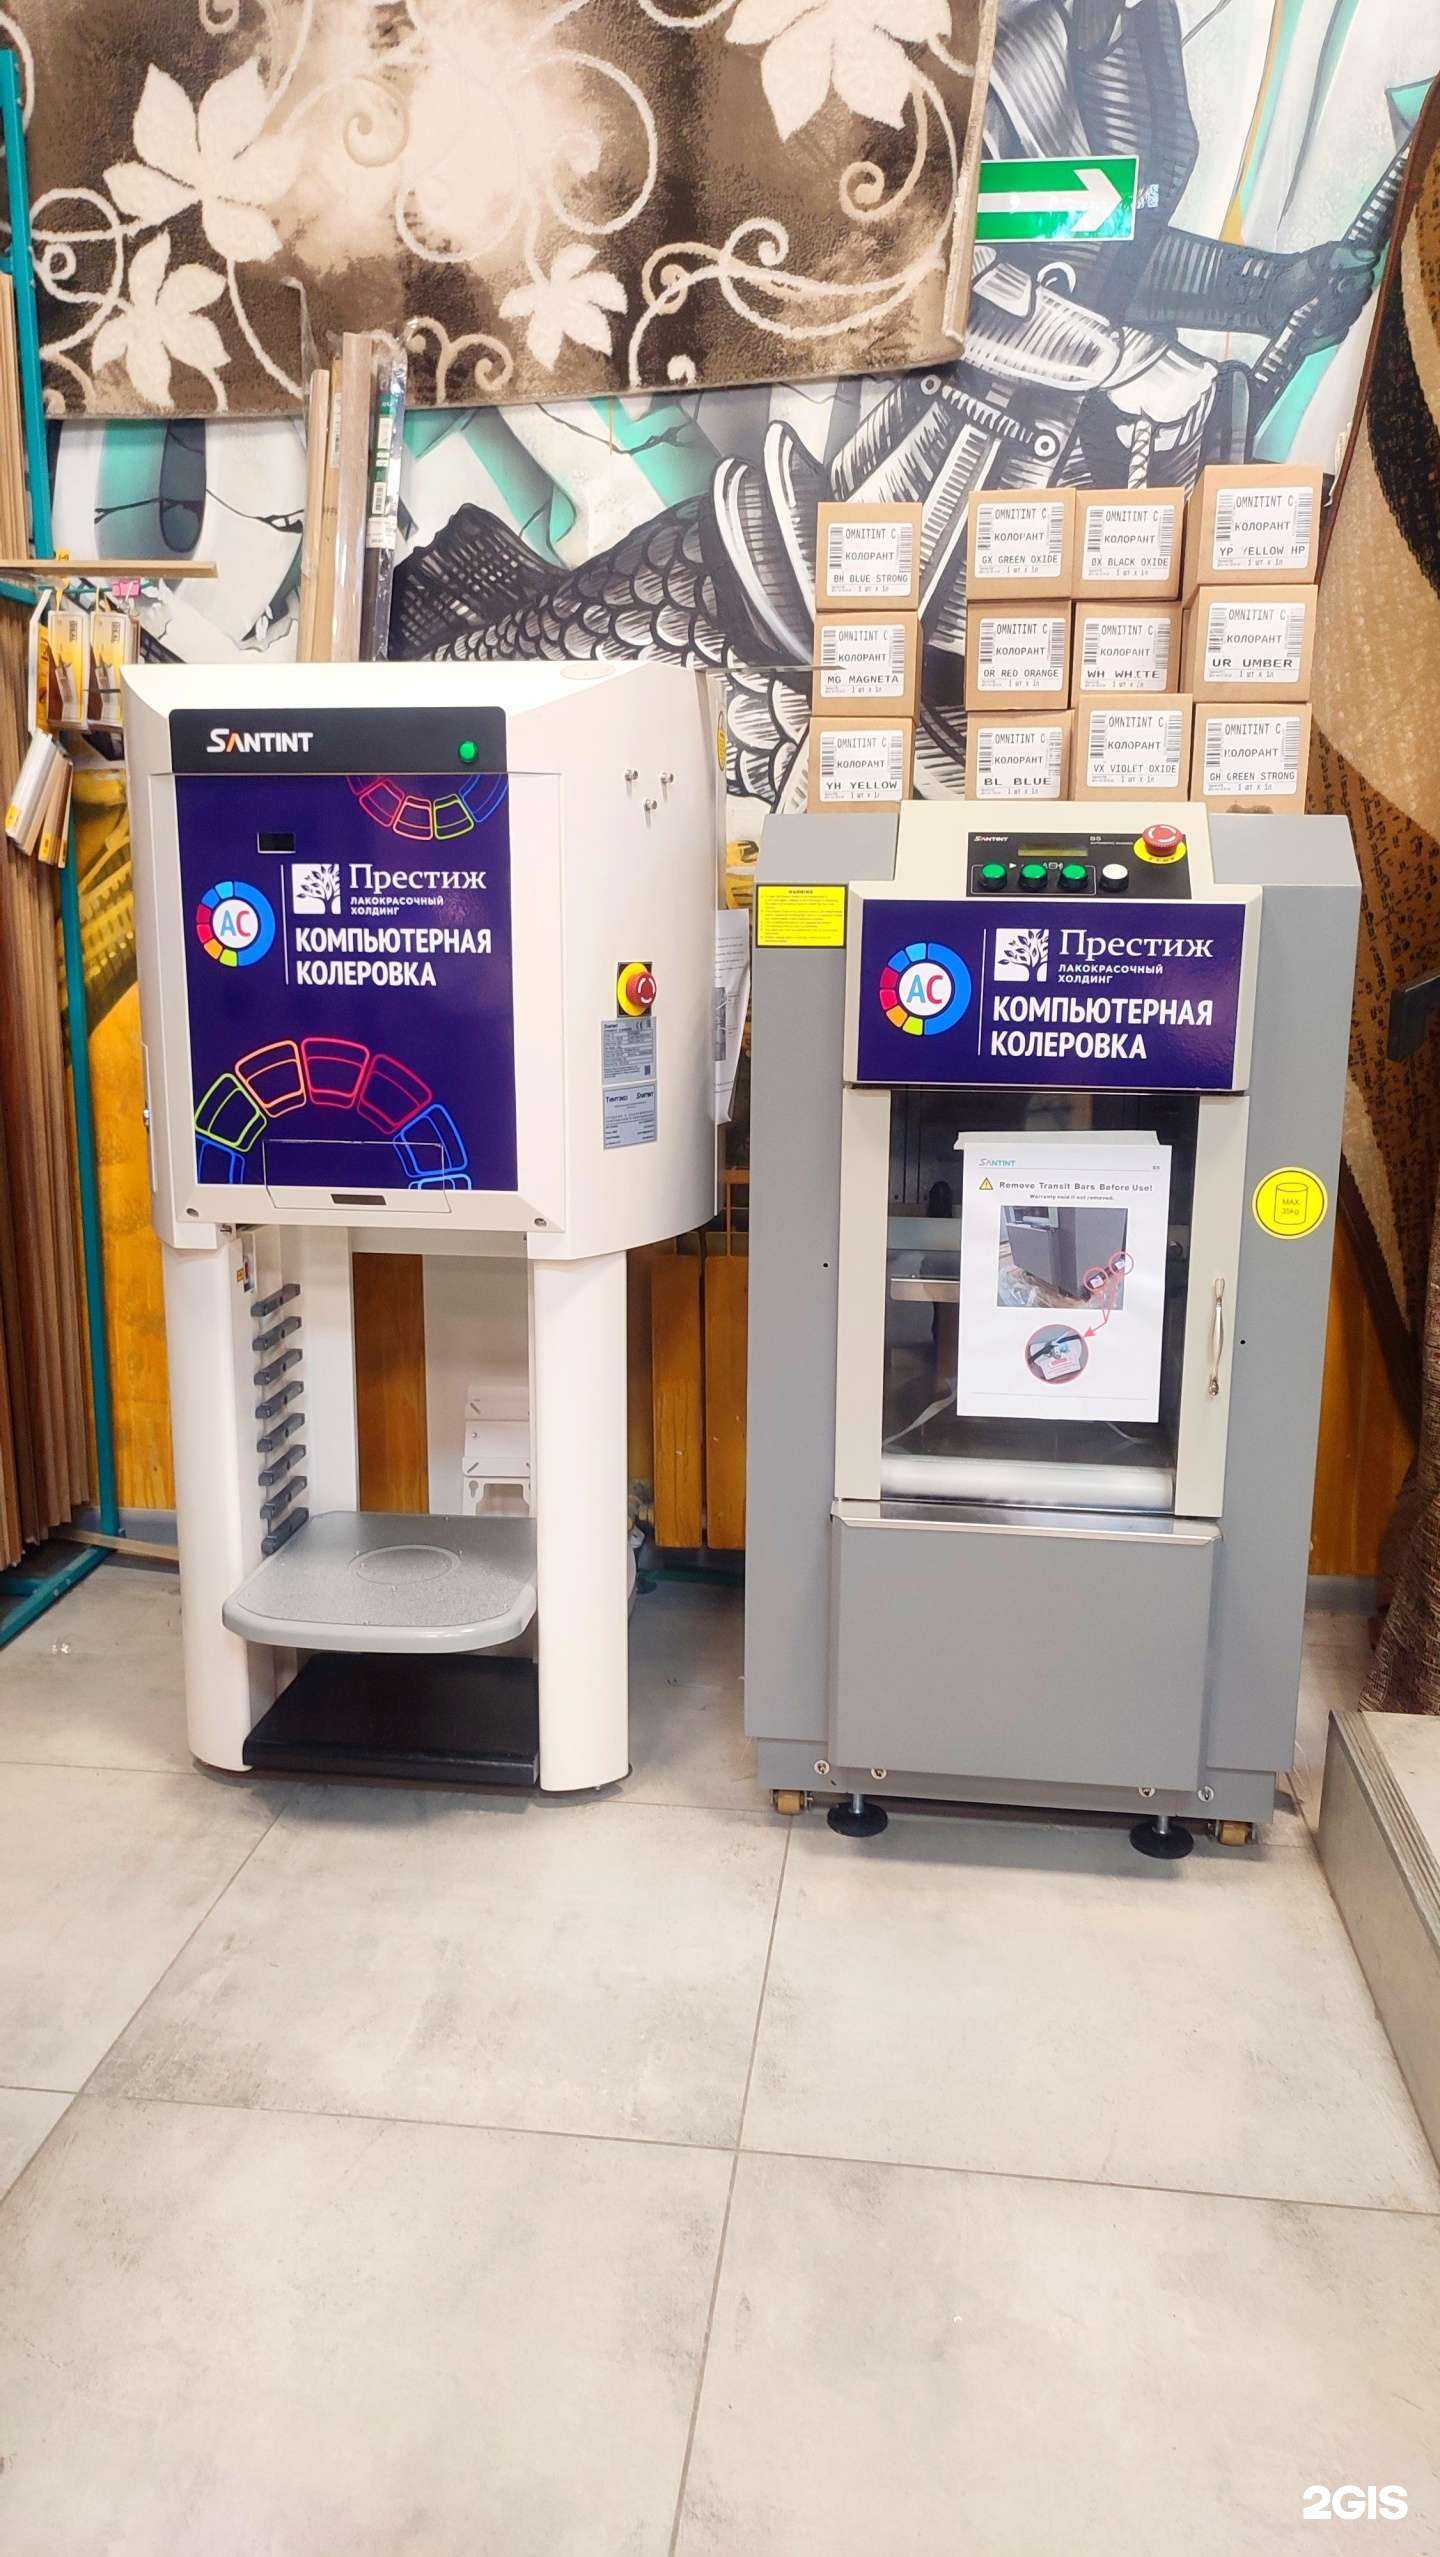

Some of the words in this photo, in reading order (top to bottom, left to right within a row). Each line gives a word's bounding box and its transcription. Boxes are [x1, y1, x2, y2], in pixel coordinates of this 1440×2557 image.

[1236, 496, 1282, 508] OMNITINT
[1288, 495, 1293, 506] C
[995, 509, 1036, 519] OMNITINT
[1042, 509, 1046, 518] C
[1106, 511, 1147, 521] OMNITINT
[1153, 511, 1158, 521] C
[1235, 522, 1289, 531] КОЛОРАНТ
[846, 529, 885, 538] OMNITINT
[891, 529, 896, 539] C
[995, 533, 1044, 541] КОЛОРАНТ
[846, 552, 893, 560] КОЛОРАНТ
[1220, 548, 1233, 556] YP
[1292, 546, 1305, 554] HP
[1108, 558, 1135, 566] BLACK
[1141, 558, 1168, 566] OXIDE
[1229, 609, 1274, 620] OMNITINT
[1280, 610, 1286, 620] C
[997, 624, 1036, 634] OMNITINT
[1043, 624, 1047, 633] C
[1102, 625, 1142, 635] OMNITINT
[1148, 625, 1153, 635] C
[839, 631, 878, 640] OMNITINT
[884, 631, 888, 640] C
[1227, 635, 1281, 643] КОЛОРАНТ
[1100, 648, 1150, 656] КОЛОРАНТ
[1213, 659, 1231, 667] UR
[1243, 659, 1292, 667] UMBER
[849, 675, 898, 683] MAGNETA
[1115, 670, 1159, 678] WHITE
[1109, 717, 1152, 727] OMNITINT
[1159, 717, 1163, 727] C
[1225, 724, 1269, 735] OMNITINT
[1276, 724, 1280, 733] C
[206, 728, 313, 753] SANTINT
[837, 738, 876, 748] OMNITINT
[882, 737, 886, 747] C
[995, 734, 1035, 744] OMNITINT
[1041, 734, 1045, 743] C
[1225, 749, 1278, 757] КОЛОРАНТ
[1149, 765, 1176, 773] OXIDE
[1261, 772, 1294, 780] STRONG
[349, 863, 486, 894] Престиж
[351, 895, 444, 906] ЛАКОКРАСОЧНЫЙ
[351, 907, 399, 917] ХОЛДИНГ
[296, 928, 491, 954] КОМПЬЮТЕРНАЯ
[1058, 929, 1213, 961] Престиж
[297, 961, 436, 986] КОЛЕРОВКА
[1059, 963, 1163, 974] ЛАКОКРАСОЧНЫЙ
[1058, 974, 1112, 984] ХОЛДИНГ
[993, 996, 1213, 1025] КОМПЬЮТЕРНАЯ
[991, 1031, 1147, 1059] КОЛЕРОВКА
